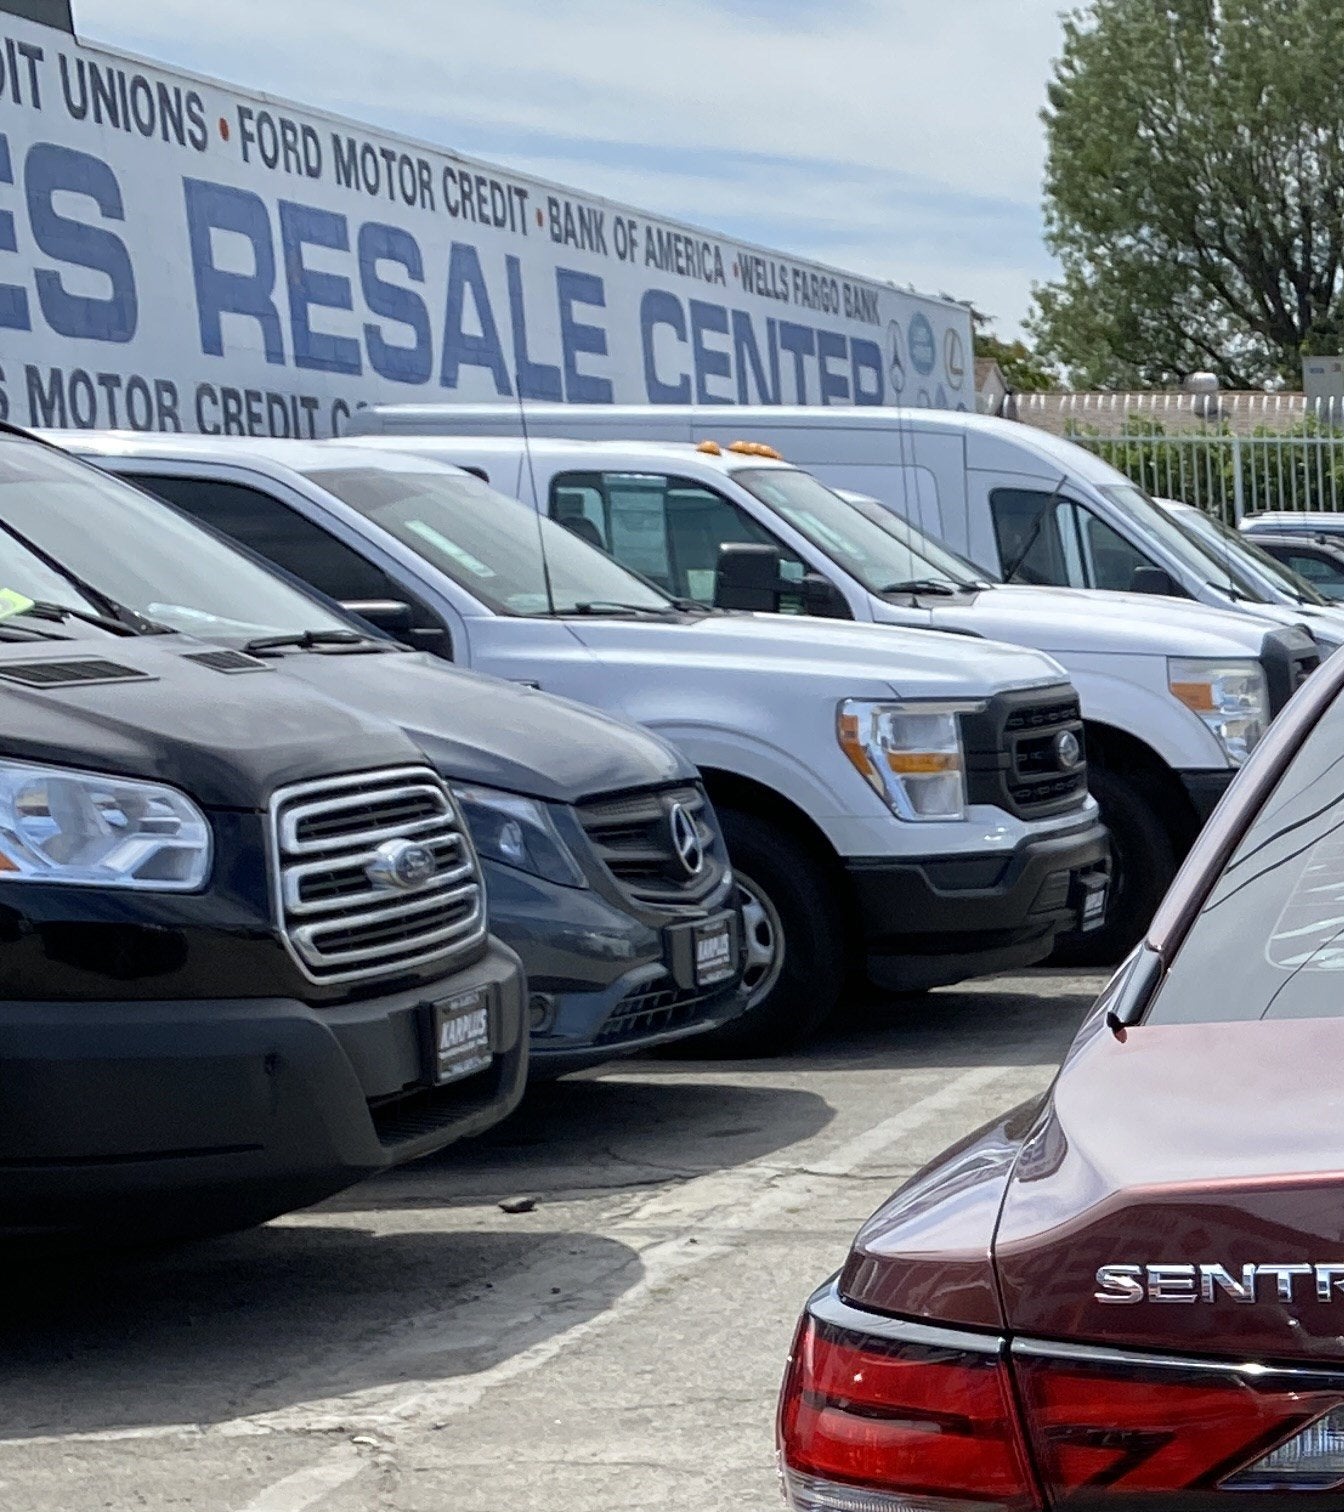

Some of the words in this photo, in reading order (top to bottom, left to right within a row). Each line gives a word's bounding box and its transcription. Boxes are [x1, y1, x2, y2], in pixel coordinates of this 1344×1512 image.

[58, 52, 209, 151] UNIONS
[236, 104, 323, 179] FORD
[331, 132, 436, 211] MOTOR
[442, 165, 530, 236] CREDIT
[547, 195, 608, 256] BANK
[613, 215, 638, 264] OF
[644, 225, 727, 287] AMERICA
[737, 252, 789, 304] WELLS
[791, 266, 840, 315] FARGO
[842, 282, 881, 327] BANK
[181, 176, 614, 402] RESALE
[640, 288, 885, 406] CENTER
[25, 364, 182, 433] MOTOR
[195, 381, 319, 440] CREDIT
